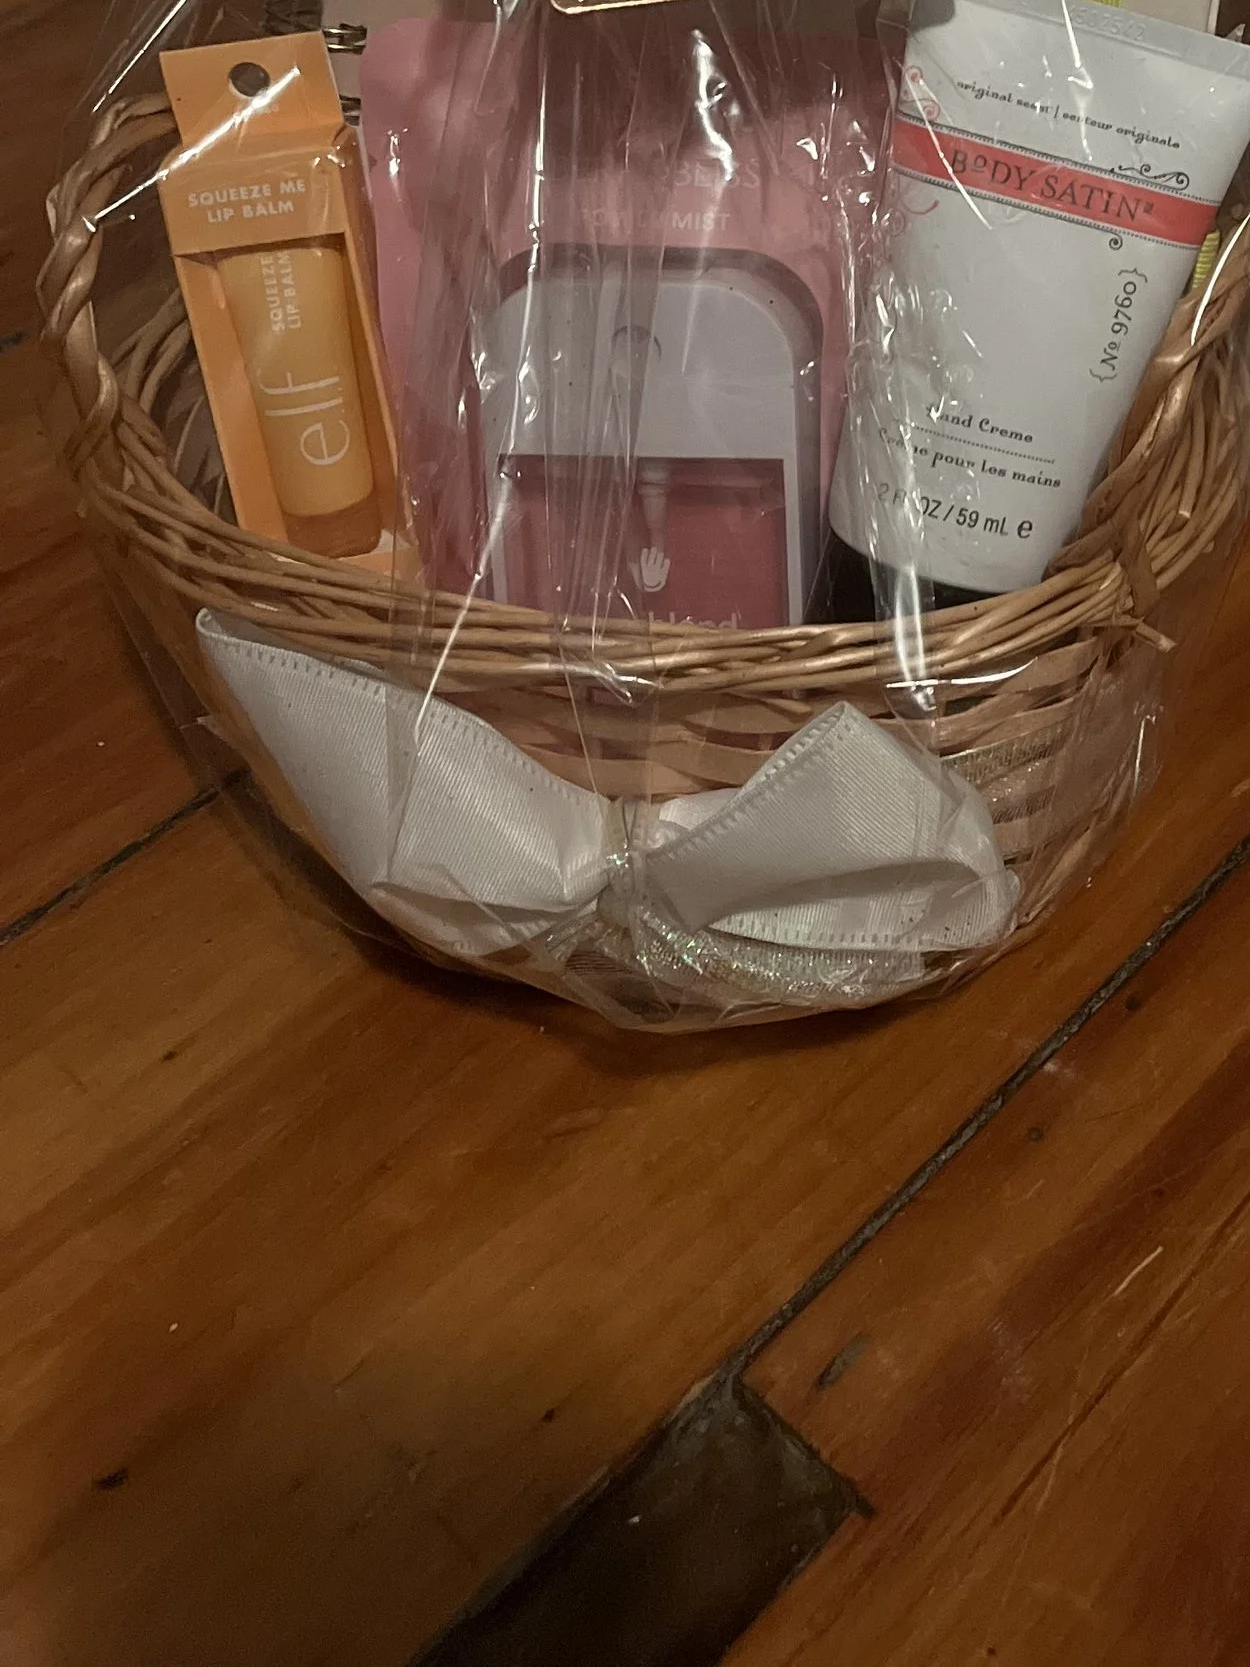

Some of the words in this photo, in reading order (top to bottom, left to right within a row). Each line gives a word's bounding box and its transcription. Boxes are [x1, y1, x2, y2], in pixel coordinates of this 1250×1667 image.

[957, 81, 1013, 100] original
[1116, 125, 1181, 151] originale
[188, 184, 272, 208] SQUEEZE
[280, 179, 306, 194] ME
[207, 207, 235, 223] LIP
[242, 200, 295, 219] BALM
[260, 255, 286, 335] SQUEEZE
[931, 451, 976, 468] pour
[981, 459, 1007, 478] les
[1012, 470, 1062, 488] mains
[956, 507, 980, 529] 59
[983, 516, 1009, 537] mL
